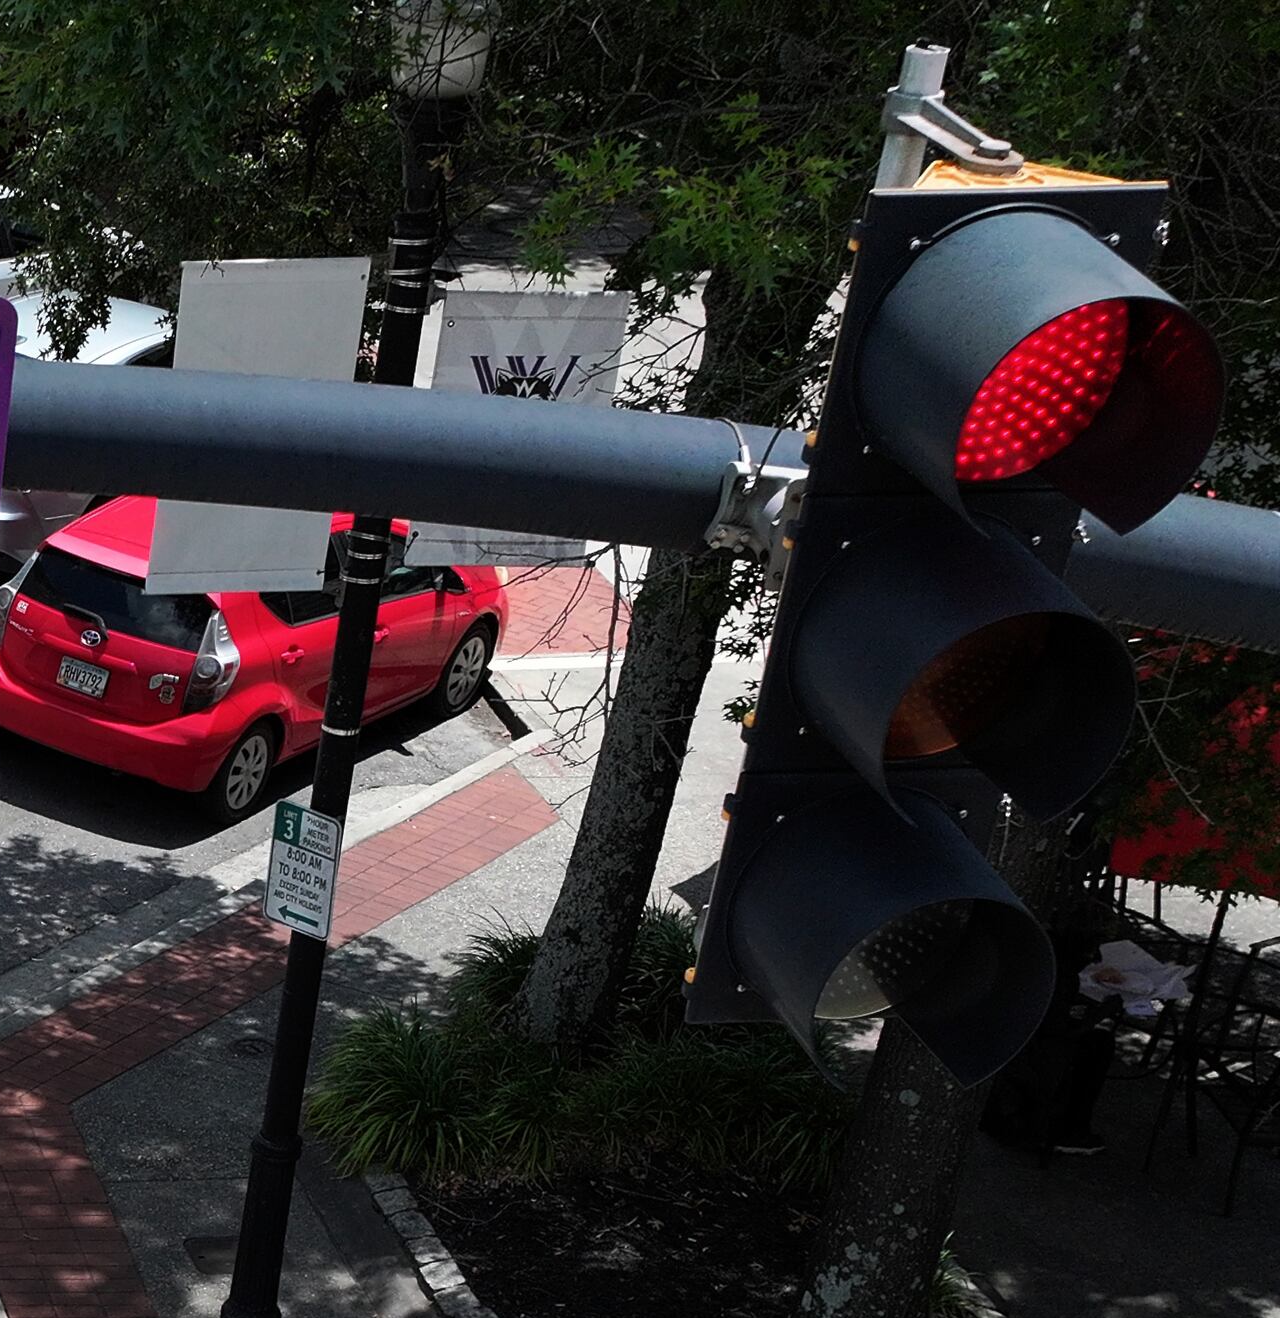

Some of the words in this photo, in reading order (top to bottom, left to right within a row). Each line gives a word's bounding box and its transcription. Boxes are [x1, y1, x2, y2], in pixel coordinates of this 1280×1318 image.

[63, 664, 103, 691] RHV3792
[283, 819, 294, 840] 3
[307, 828, 330, 843] METER
[302, 837, 332, 855] PARKING
[287, 847, 307, 865] 8:00
[308, 856, 322, 871] AM
[279, 862, 290, 876] TO
[292, 867, 311, 885] 8:00
[313, 876, 327, 891] PM
[274, 889, 285, 899] AND
[285, 894, 298, 904] CITY
[299, 900, 322, 914] HOLIDAYS
[279, 880, 299, 893] EXCEPT
[300, 888, 320, 901] SUNDAY
